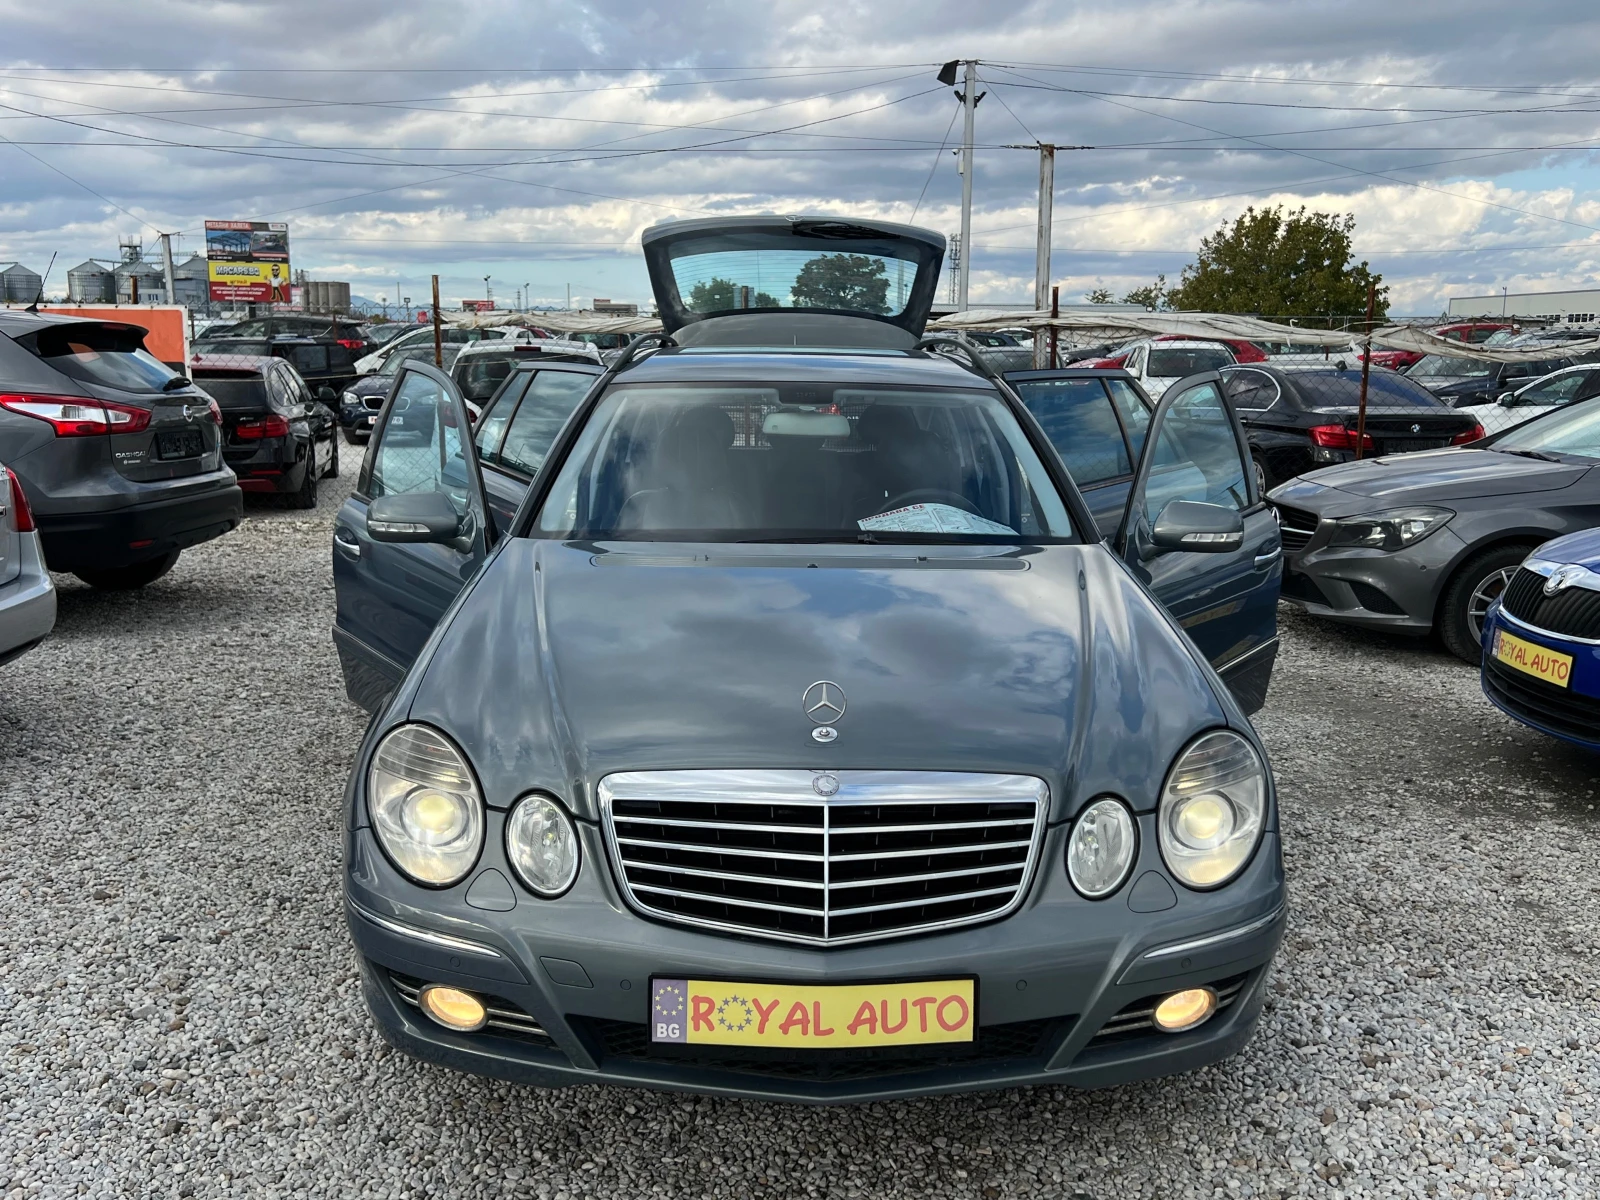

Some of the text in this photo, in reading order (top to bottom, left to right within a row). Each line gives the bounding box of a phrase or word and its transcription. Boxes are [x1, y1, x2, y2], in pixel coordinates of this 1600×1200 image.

[1530, 653, 1569, 680] AUTO
[656, 1022, 680, 1039] BG
[846, 994, 970, 1035] AUTO
